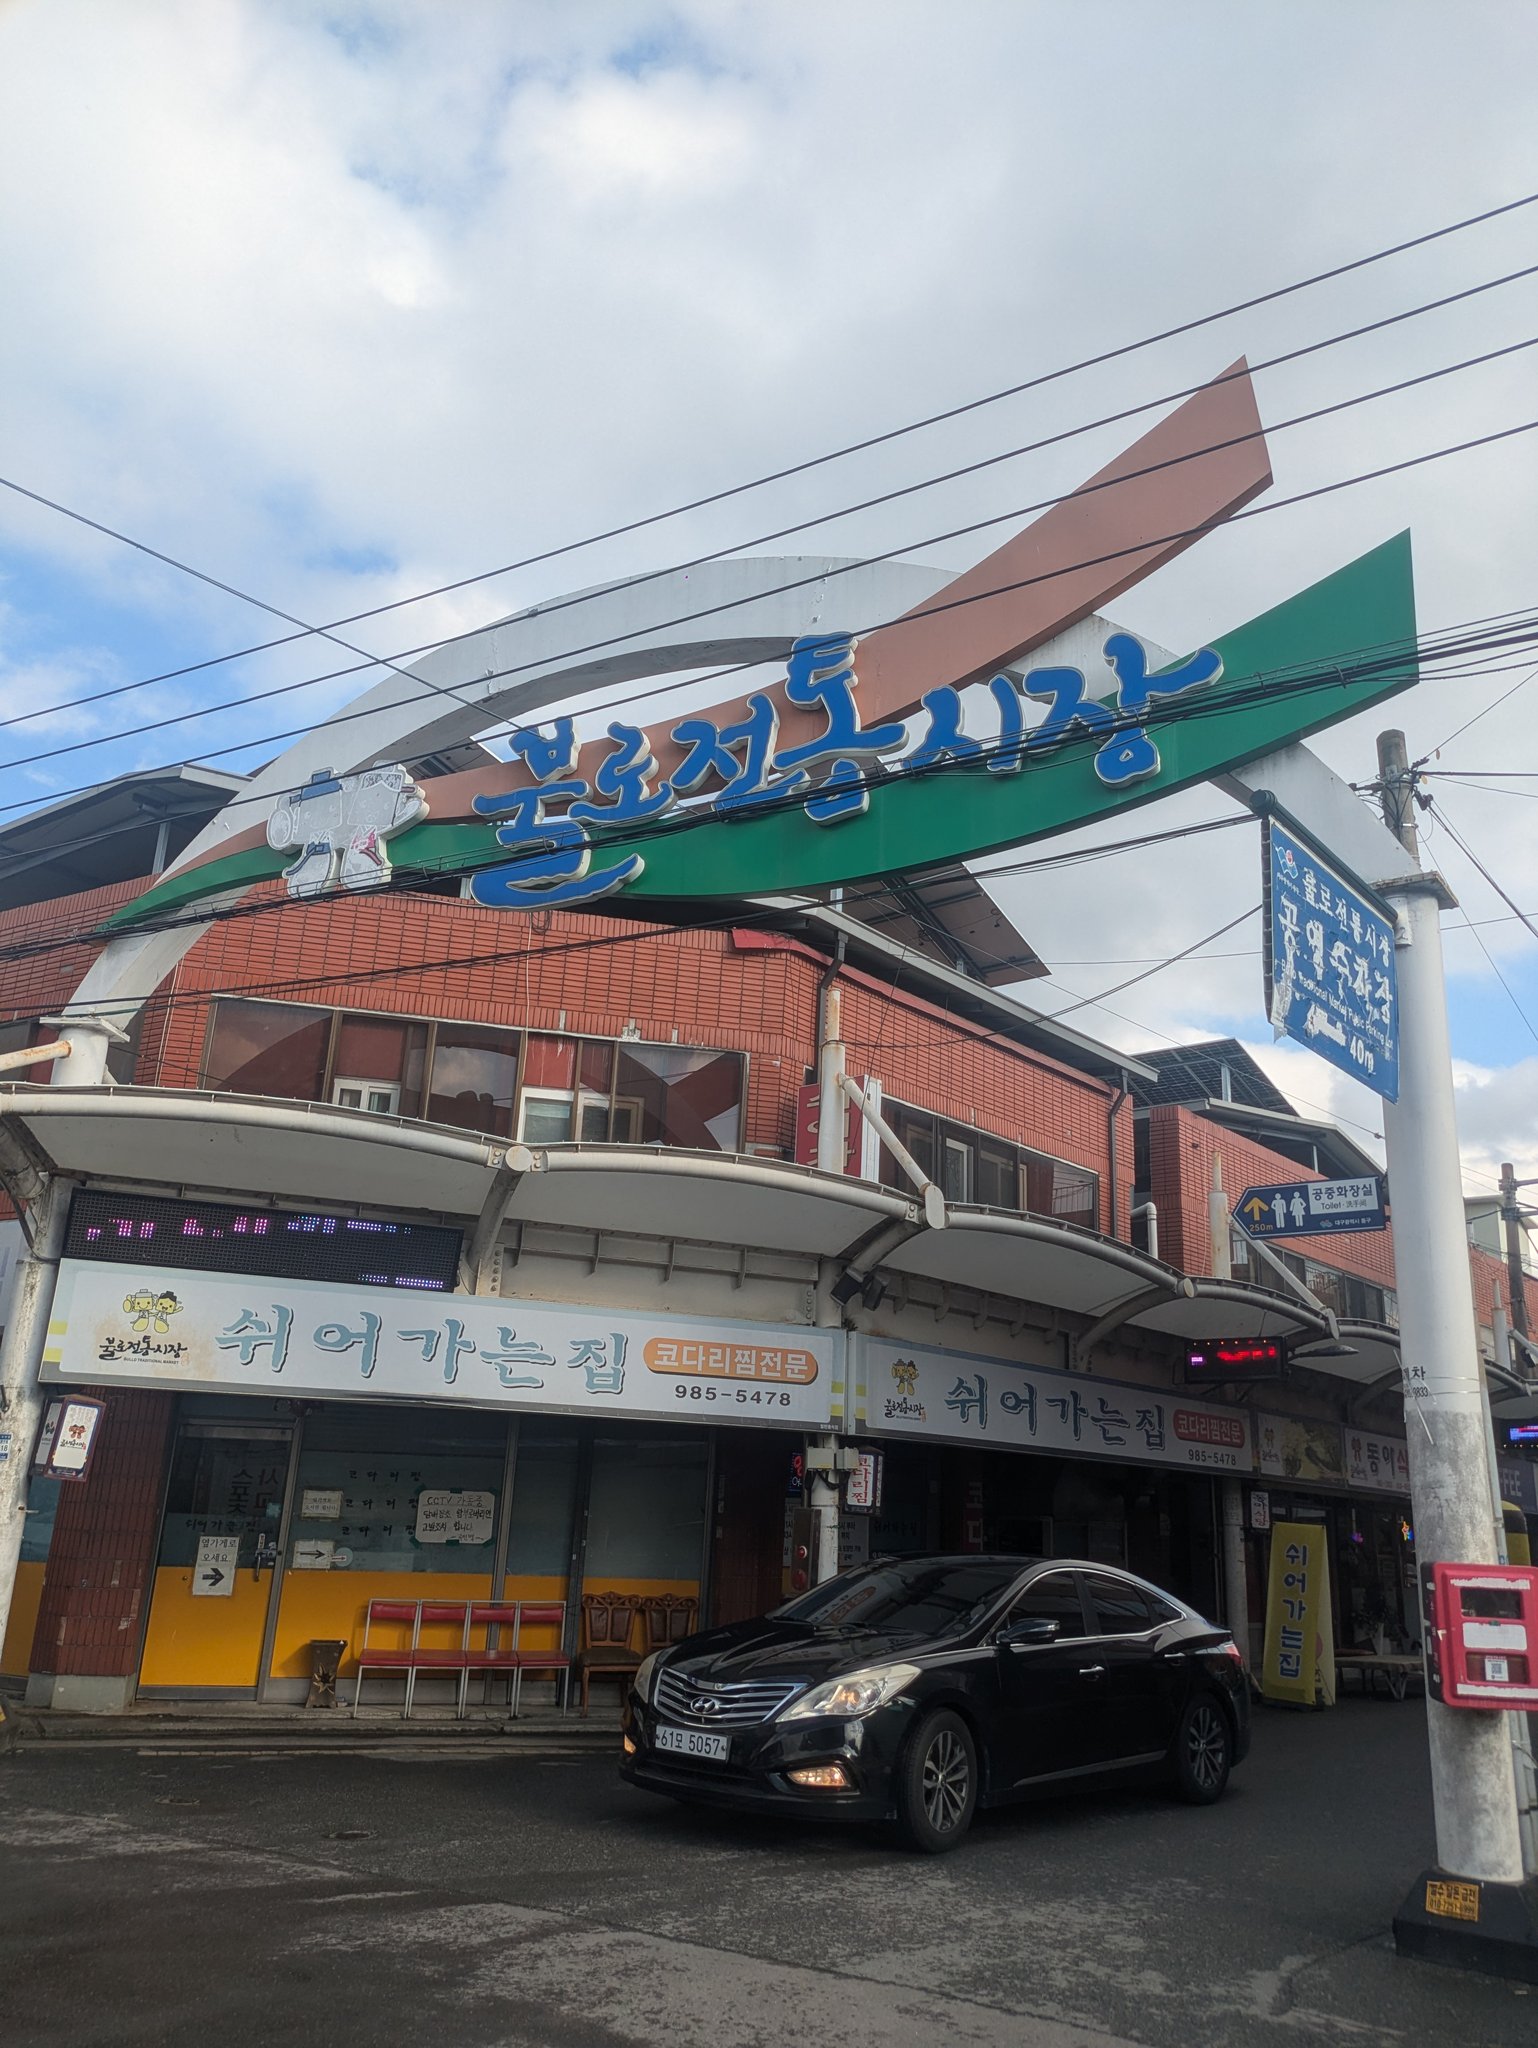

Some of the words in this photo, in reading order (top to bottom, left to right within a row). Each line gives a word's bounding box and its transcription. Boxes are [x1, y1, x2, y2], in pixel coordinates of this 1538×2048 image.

[471, 632, 1223, 911] 불로전통시장
[1350, 1034, 1374, 1073] 40m
[1312, 1183, 1373, 1201] 공중화장실
[1321, 1201, 1341, 1210] Toilet
[1249, 1223, 1273, 1232] 250m
[1334, 1218, 1359, 1226] 대구광역시
[99, 1335, 188, 1361] 불로전통시장
[216, 1304, 628, 1394] 쉬어가는집
[654, 1342, 809, 1380] 코다리찜전문
[675, 1384, 791, 1407] 985-5478
[945, 1373, 1167, 1451] 쉬어가는집
[1178, 1414, 1241, 1443] 코다리찜전문
[1188, 1448, 1237, 1466] 985-5478
[427, 1496, 453, 1505] CCTV
[453, 1520, 473, 1532] 합니다
[202, 1538, 237, 1548] 옆가게로
[1279, 1543, 1308, 1679] 쉬어가는집
[660, 1729, 683, 1749] 61모
[688, 1734, 720, 1756] 5057
